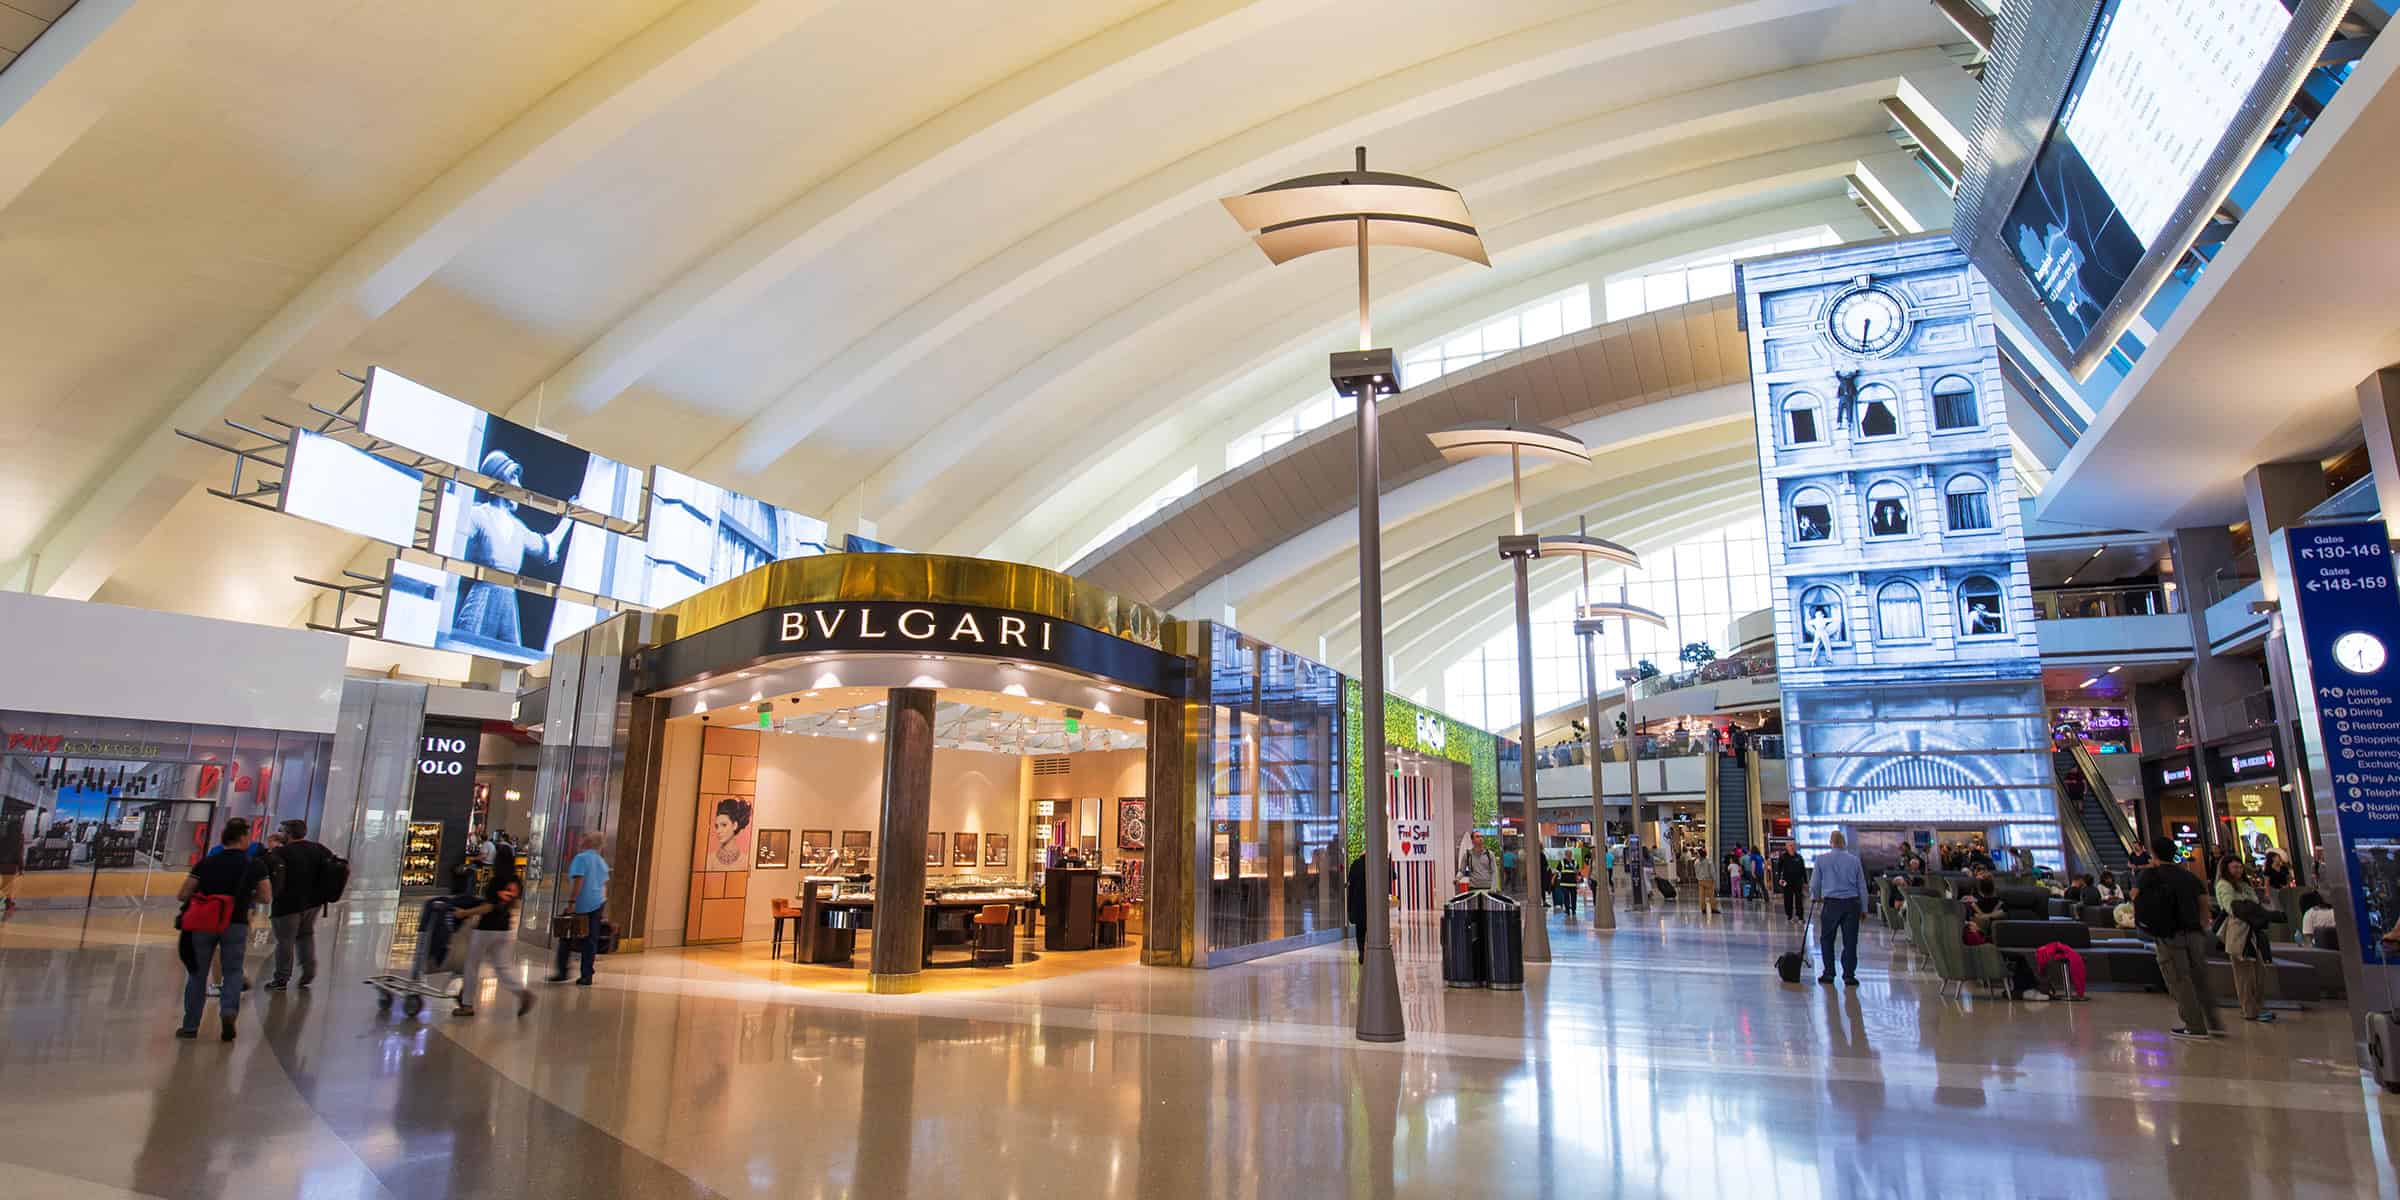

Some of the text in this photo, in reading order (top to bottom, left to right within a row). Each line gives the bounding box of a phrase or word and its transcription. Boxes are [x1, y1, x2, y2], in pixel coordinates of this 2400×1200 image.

[2314, 536, 2344, 544] Gates
[2315, 544, 2381, 559] 130-146
[2320, 567, 2351, 576] Gates
[2321, 576, 2387, 591] 148-159
[780, 608, 1051, 651] BVLGARI
[2346, 687, 2379, 697] Airline
[2347, 697, 2393, 706] Lounges
[2350, 708, 2384, 717] Dining
[421, 736, 466, 753] INO
[2362, 774, 2400, 784] Play Ar
[2364, 788, 2400, 798] Teleph
[2368, 811, 2399, 821] Room
[1413, 843, 1428, 855] YOU
